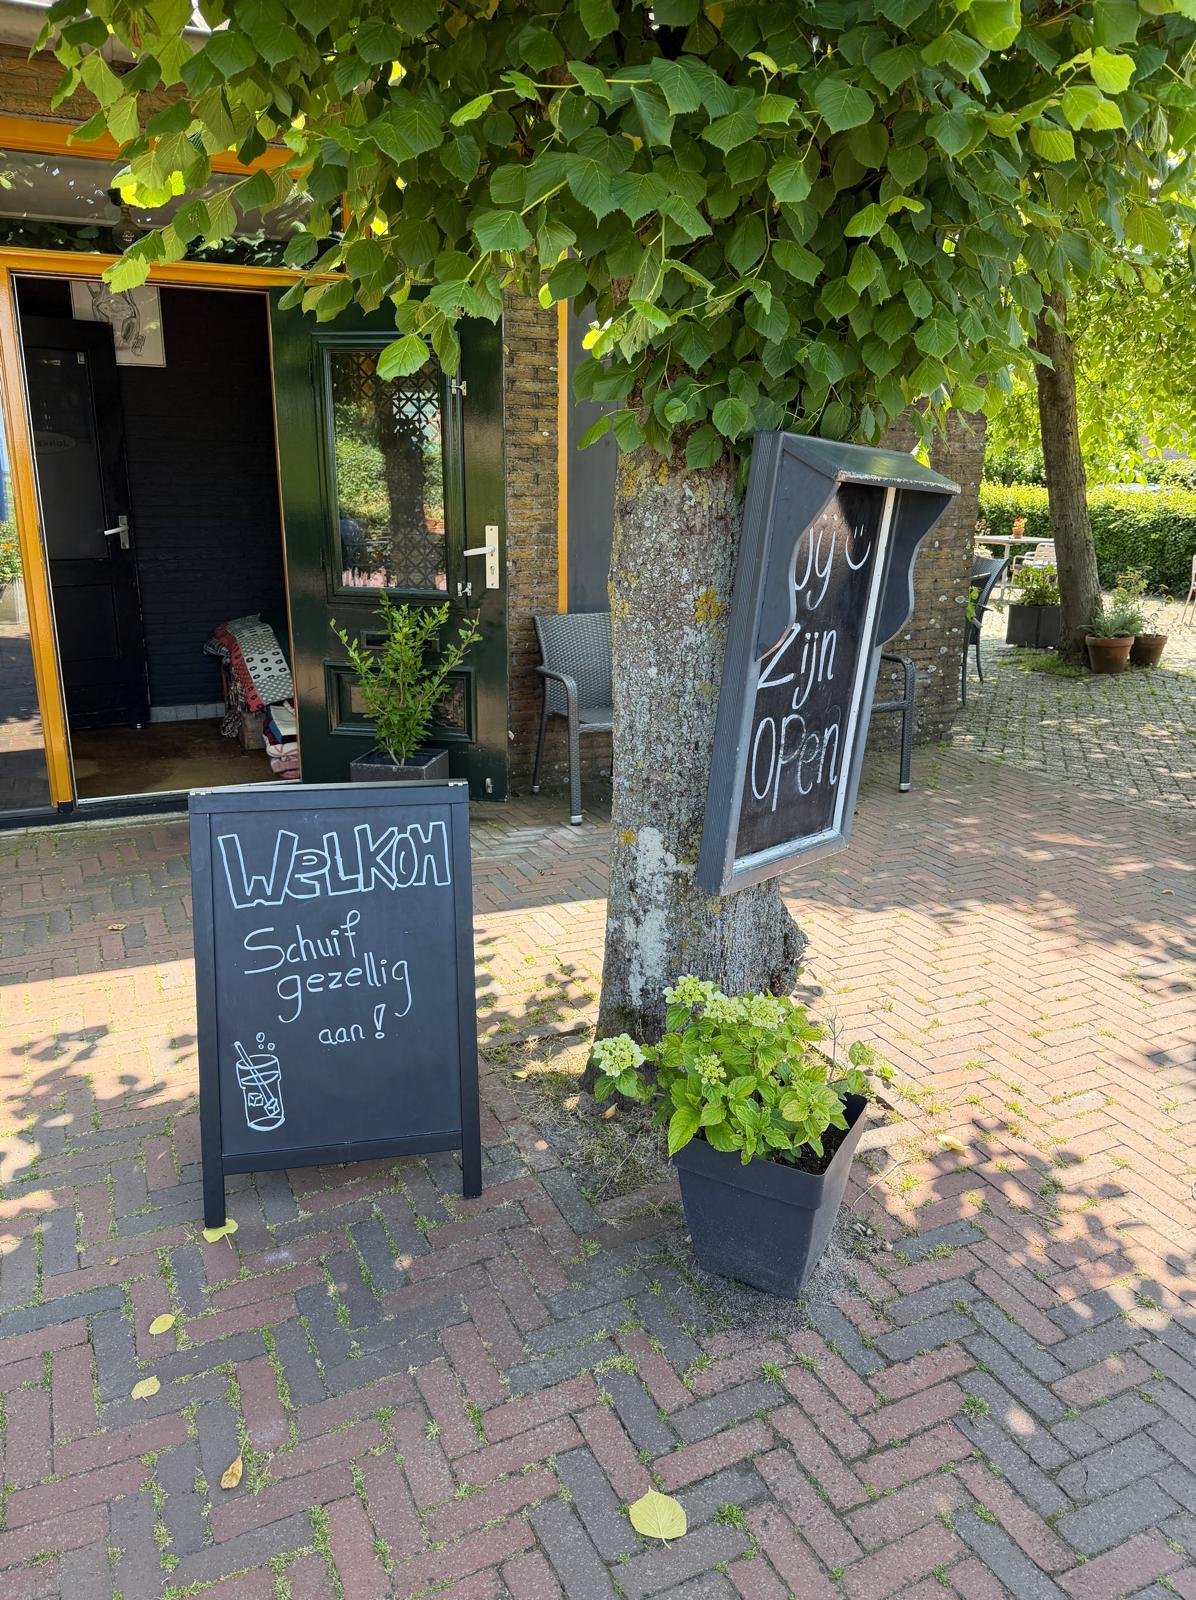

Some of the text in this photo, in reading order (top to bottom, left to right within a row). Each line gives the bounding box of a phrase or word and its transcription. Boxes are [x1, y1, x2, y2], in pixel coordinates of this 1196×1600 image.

[757, 622, 837, 710] Zijn
[243, 910, 361, 975] Schuif
[276, 951, 412, 1024] gezellig
